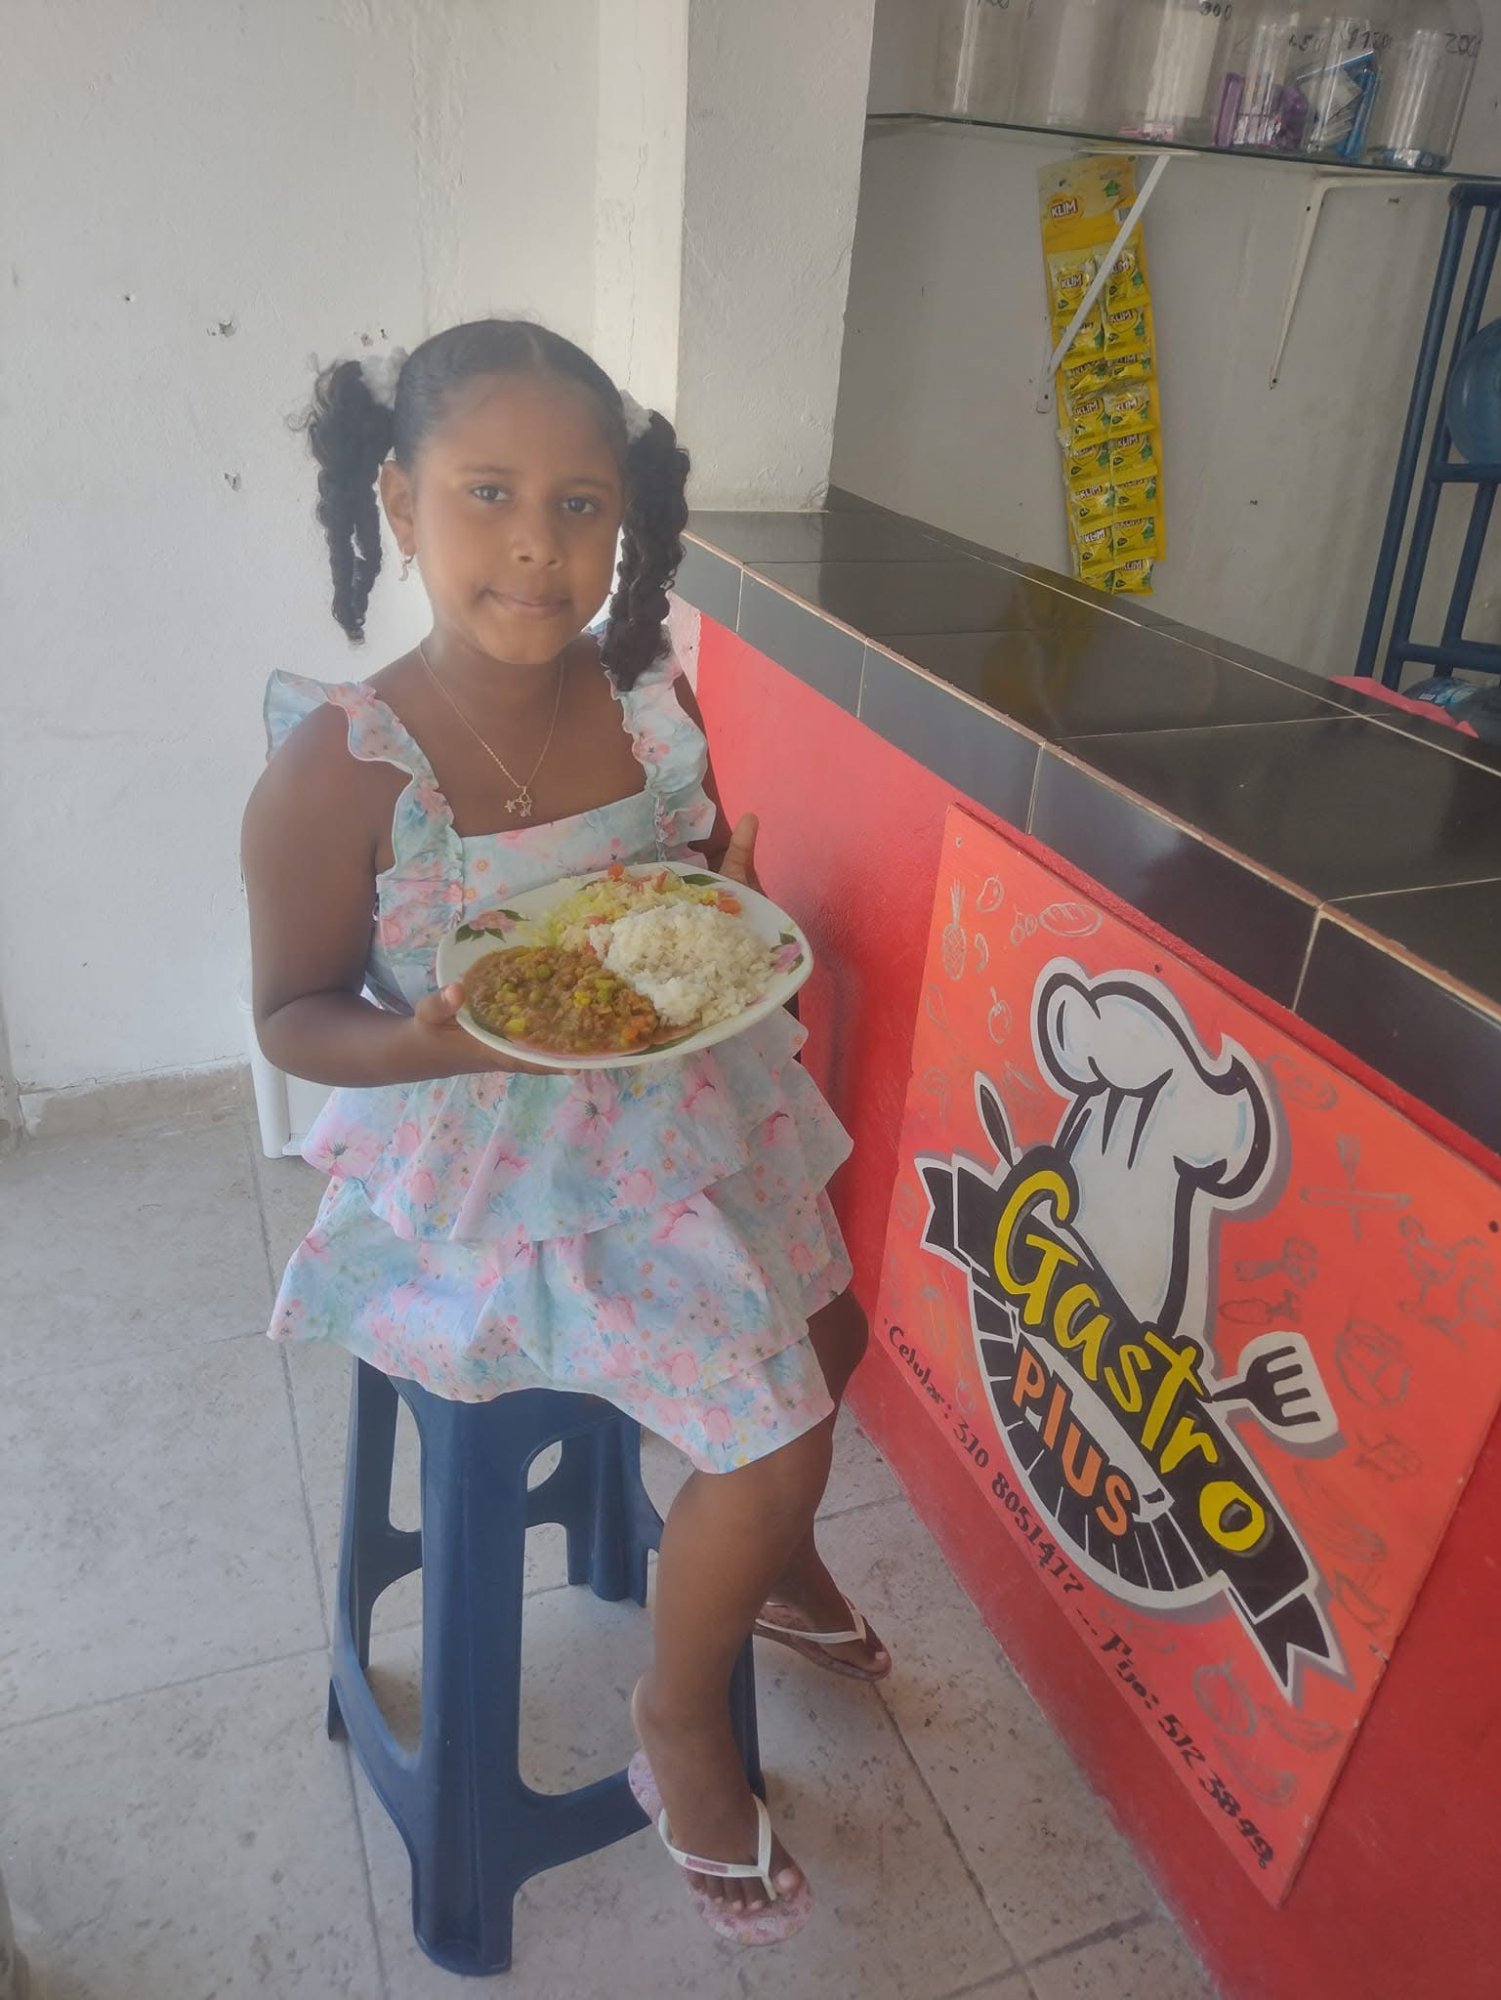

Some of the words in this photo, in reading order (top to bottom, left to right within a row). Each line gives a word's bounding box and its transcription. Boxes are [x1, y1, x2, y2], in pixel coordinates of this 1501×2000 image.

[1050, 199, 1078, 218] KLIM
[1059, 272, 1083, 289] KLIM
[1109, 308, 1134, 324] KLIM
[1075, 400, 1099, 415] KLIM
[1115, 398, 1138, 412] KLIM
[993, 1170, 1265, 1551] Gastro
[953, 1417, 990, 1469] 310
[991, 1471, 1085, 1594] 8051417
[1157, 1713, 1206, 1769] 512
